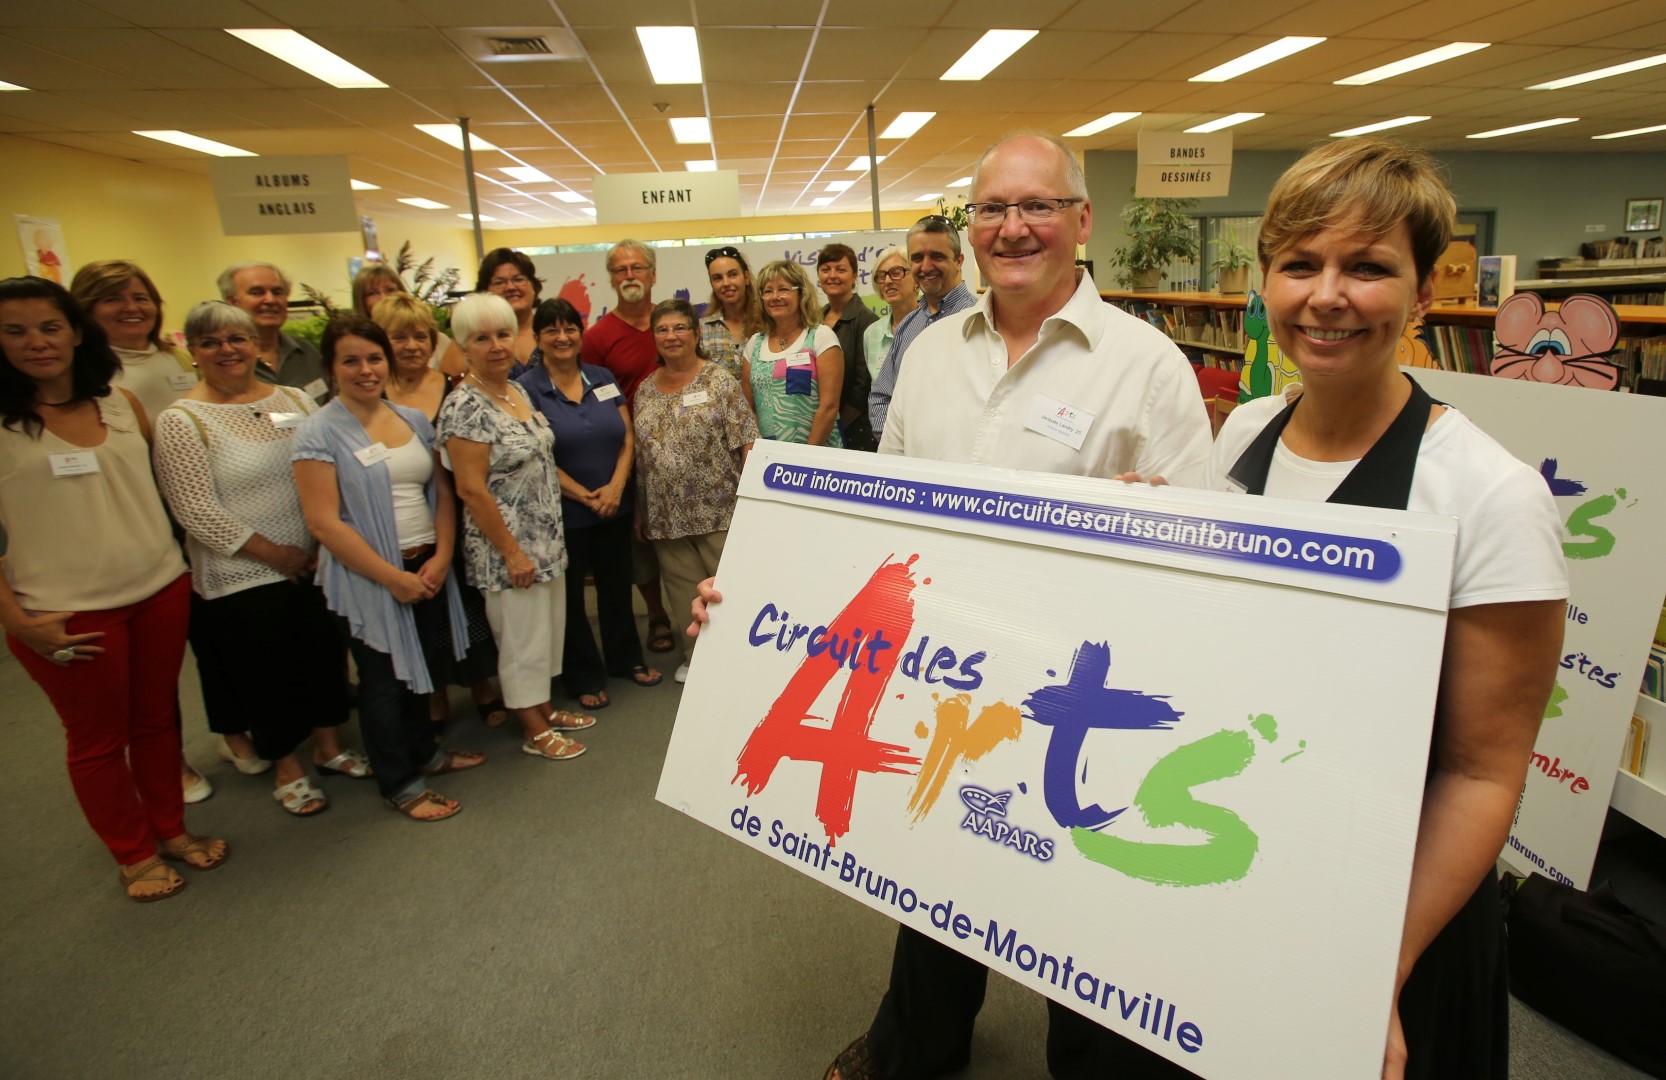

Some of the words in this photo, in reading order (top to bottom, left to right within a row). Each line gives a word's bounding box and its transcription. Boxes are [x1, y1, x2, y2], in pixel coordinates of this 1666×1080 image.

[1170, 147, 1205, 159] BANDES
[256, 174, 310, 187] ALBUMS
[1161, 169, 1212, 183] DESSINÉES
[259, 202, 316, 216] ANGLAIS
[642, 189, 692, 204] ENFANT
[772, 465, 808, 487] Pour
[810, 470, 916, 504] informations
[931, 489, 1376, 571] www.circuitdesartssaintbruno.com
[748, 602, 894, 675] Circuit
[900, 635, 988, 692] des
[731, 553, 1279, 888] Arts
[962, 811, 1054, 861] AAPARS
[730, 806, 762, 838] de
[768, 825, 1204, 1054] Saint-Bruno-de-Montarville
